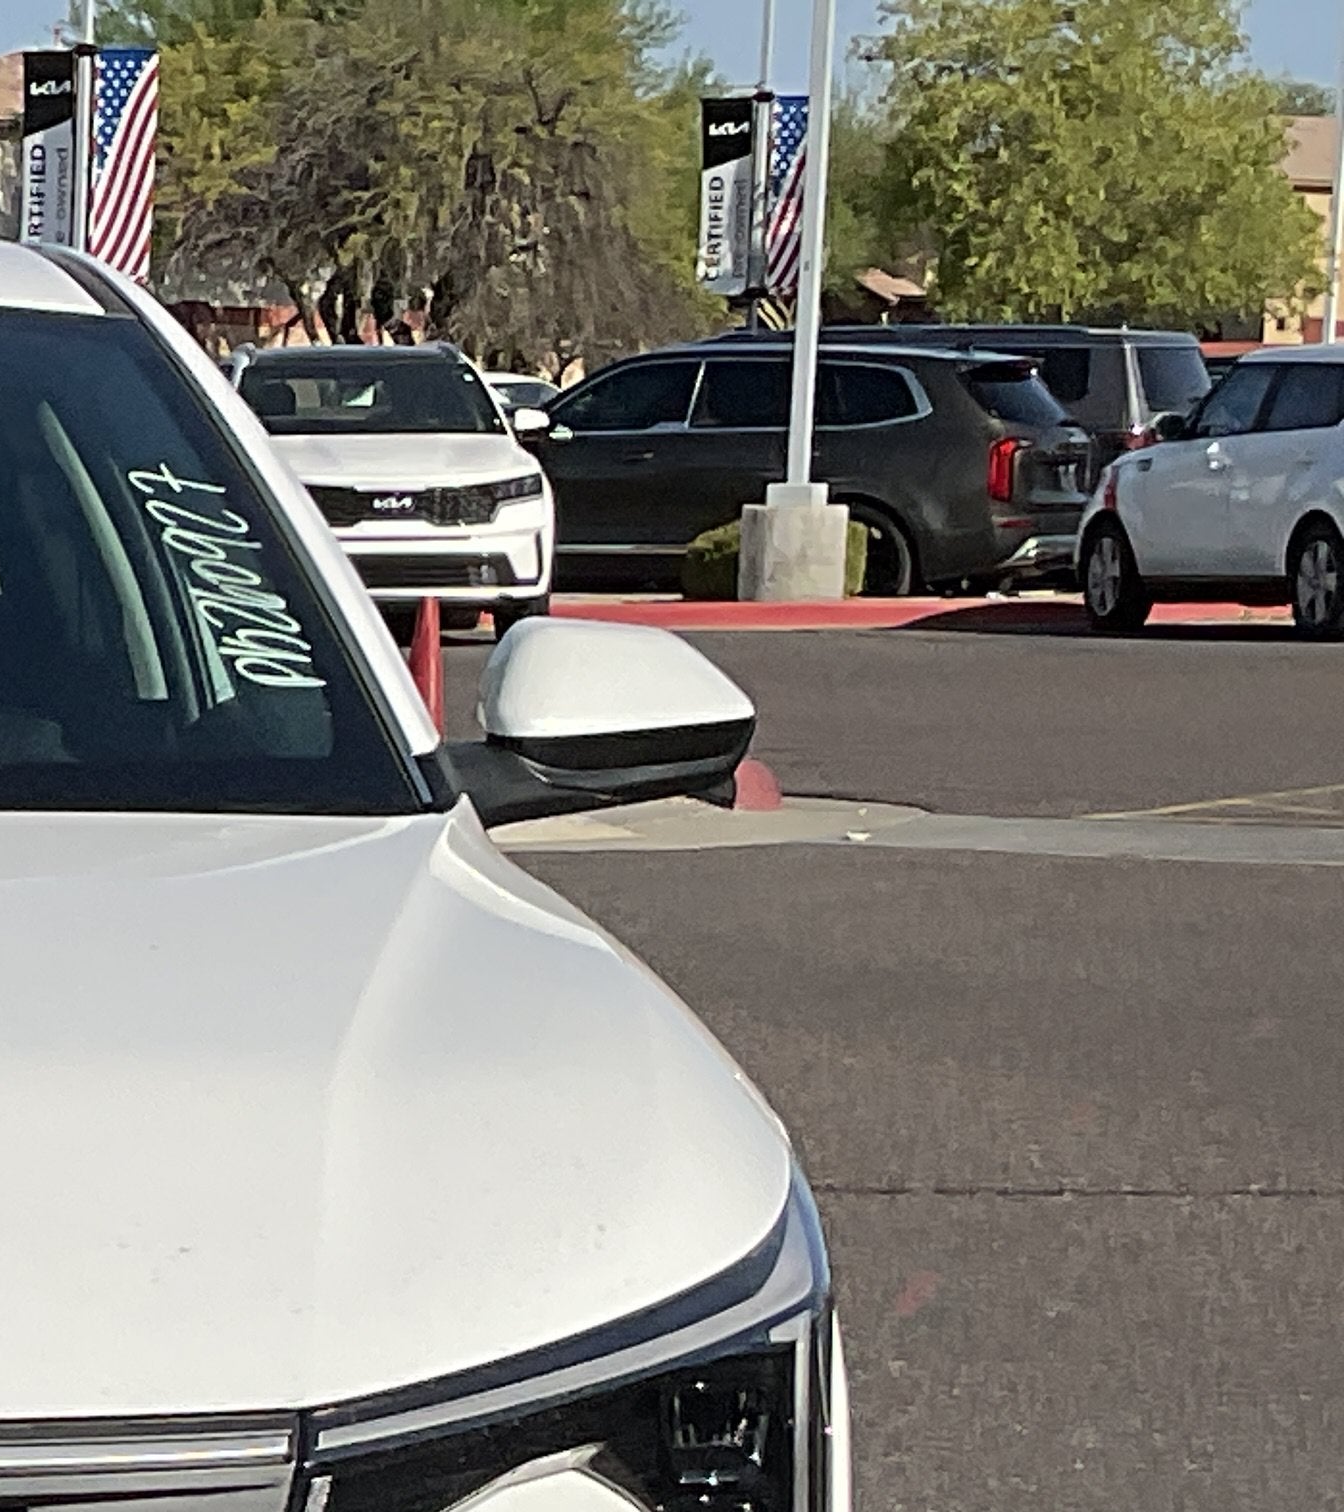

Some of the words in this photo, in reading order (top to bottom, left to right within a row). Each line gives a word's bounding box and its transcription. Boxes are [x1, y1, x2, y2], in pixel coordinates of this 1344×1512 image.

[30, 80, 71, 95] KIA
[709, 122, 749, 136] KIA
[28, 144, 46, 237] RTIFIED
